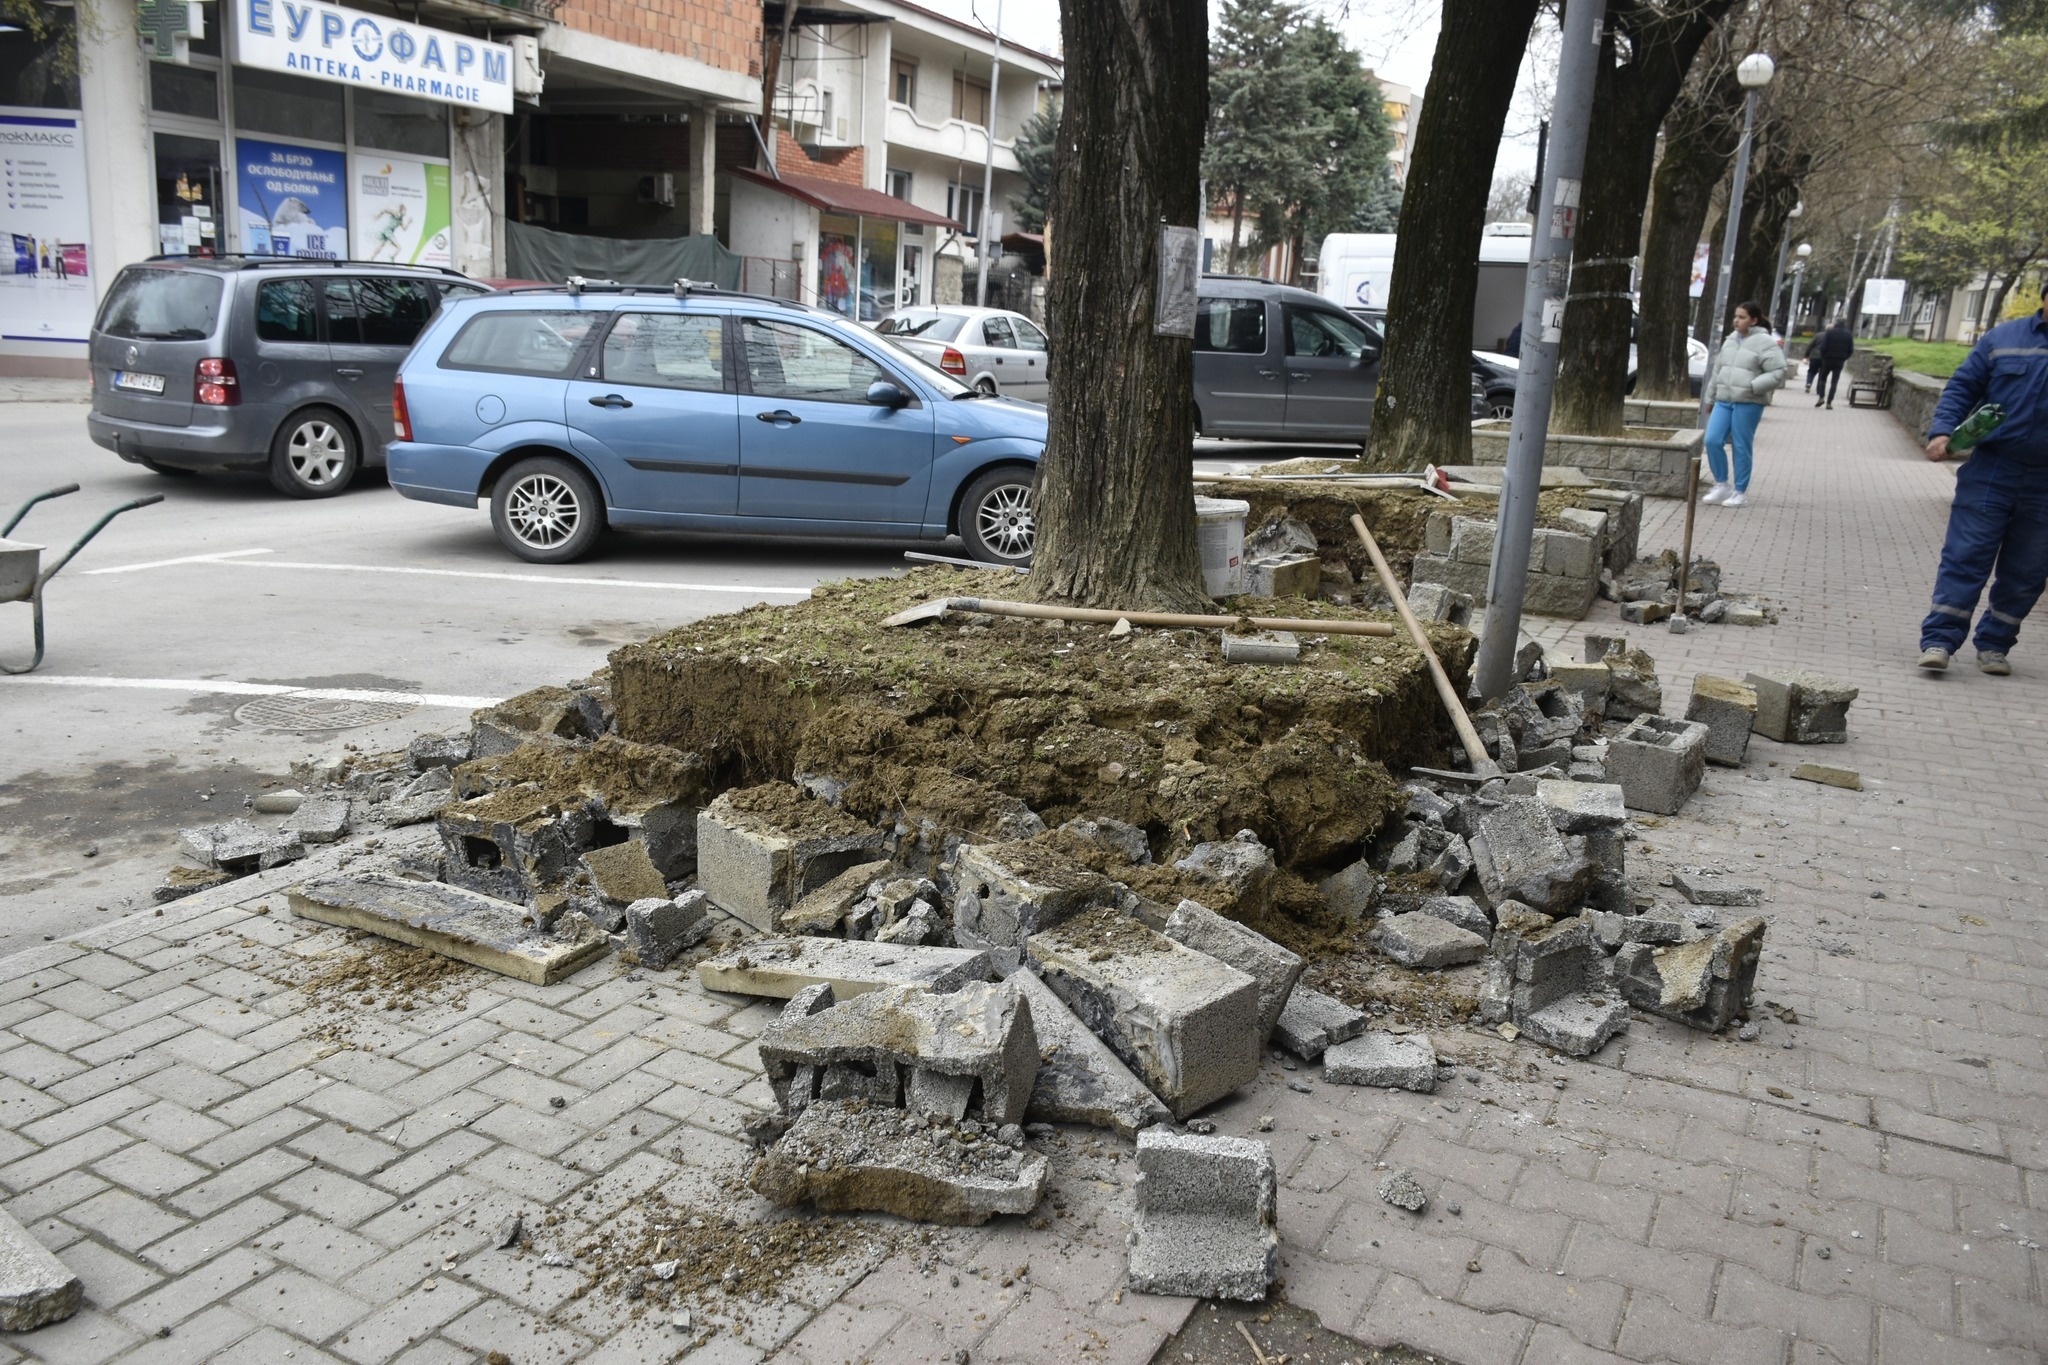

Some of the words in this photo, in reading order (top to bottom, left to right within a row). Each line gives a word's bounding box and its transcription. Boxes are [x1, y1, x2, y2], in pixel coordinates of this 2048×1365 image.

[248, 0, 506, 84] ЕУРОФАРМ
[287, 52, 361, 81] АПТЕКА
[381, 71, 479, 102] PHARMACIE
[271, 152, 284, 163] ЗА
[286, 154, 313, 167] БРЗО
[247, 164, 335, 184] ОСЛОБОДУВАЊЕ
[266, 181, 282, 193] ОД
[284, 183, 319, 195] БОЛКА
[307, 234, 326, 250] ICE
